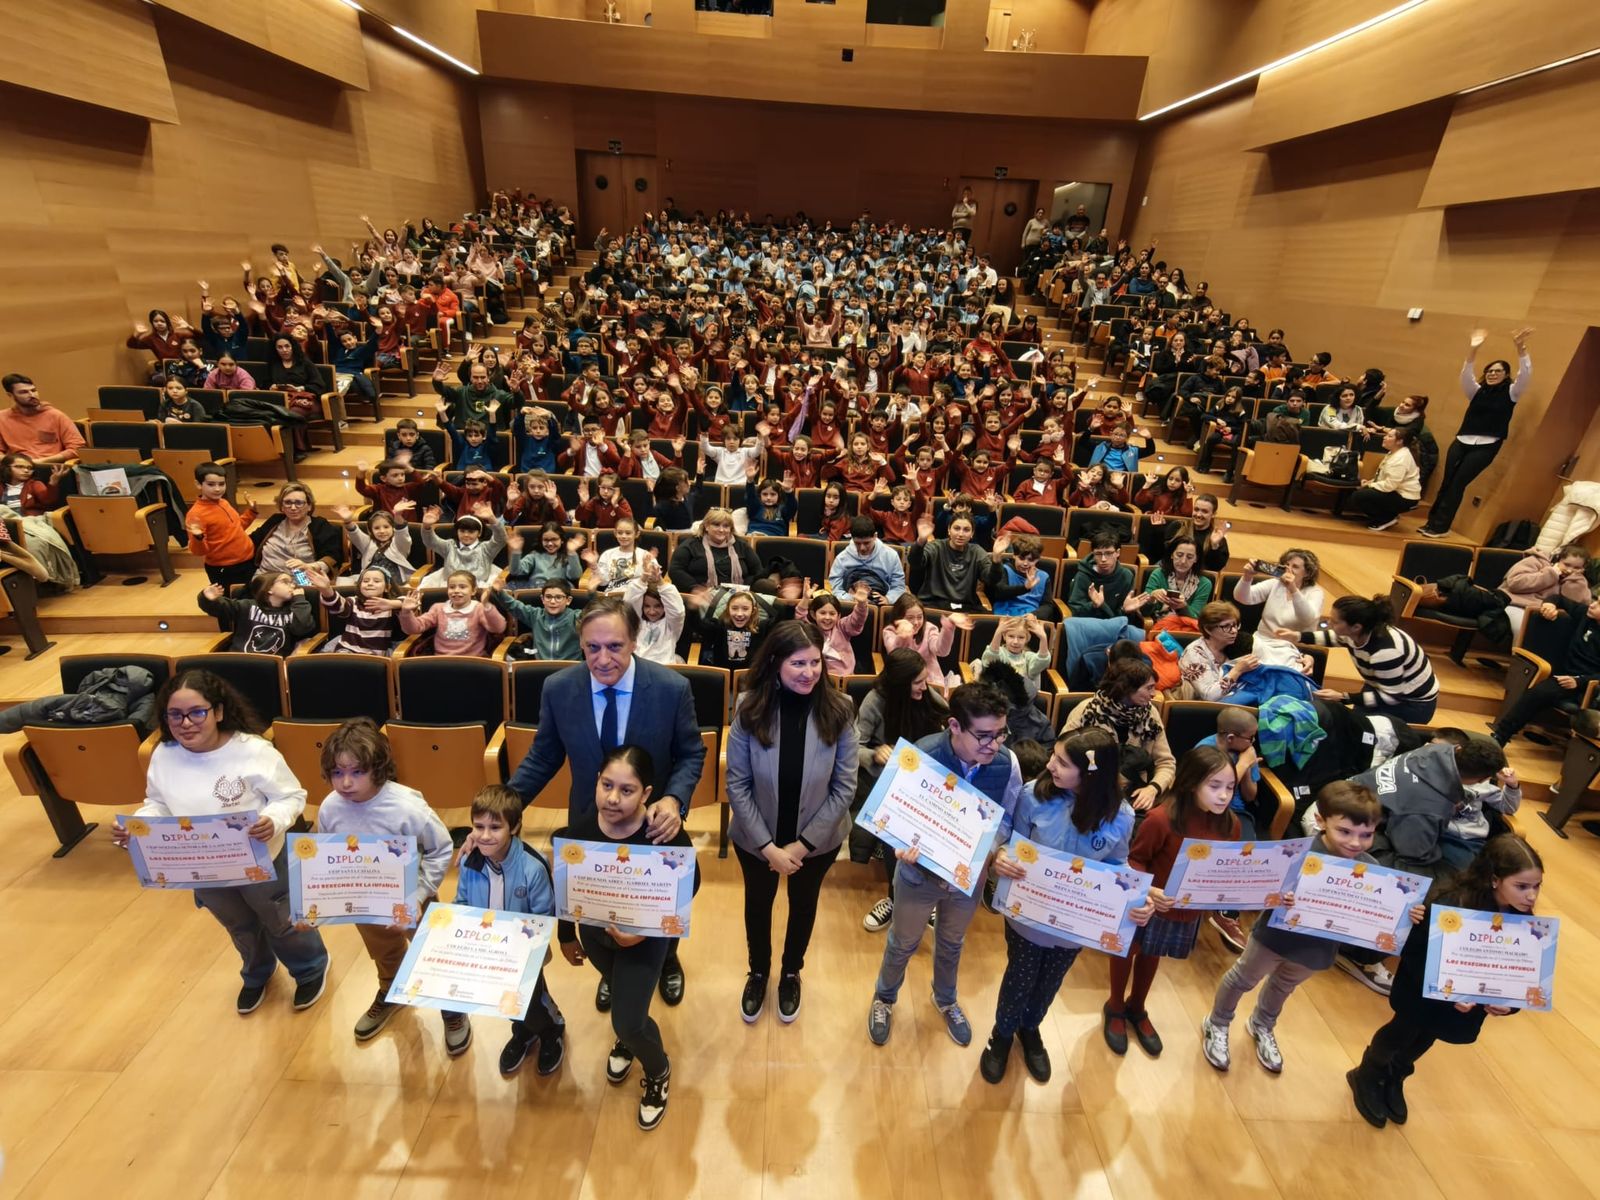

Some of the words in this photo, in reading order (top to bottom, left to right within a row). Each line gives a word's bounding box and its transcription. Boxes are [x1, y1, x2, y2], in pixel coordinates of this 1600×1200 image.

[250, 604, 294, 627] NIRVAN
[921, 779, 967, 815] DIPLOMA
[162, 832, 220, 841] DIPLOMA
[328, 855, 380, 864] DIPLOMA
[594, 864, 652, 876] DIPLOMA
[1044, 868, 1101, 891] DIPLOMA
[1326, 876, 1382, 894] DIPLOMA
[455, 929, 508, 944] DIPLOMA
[1470, 933, 1520, 944] DIPLOMA
